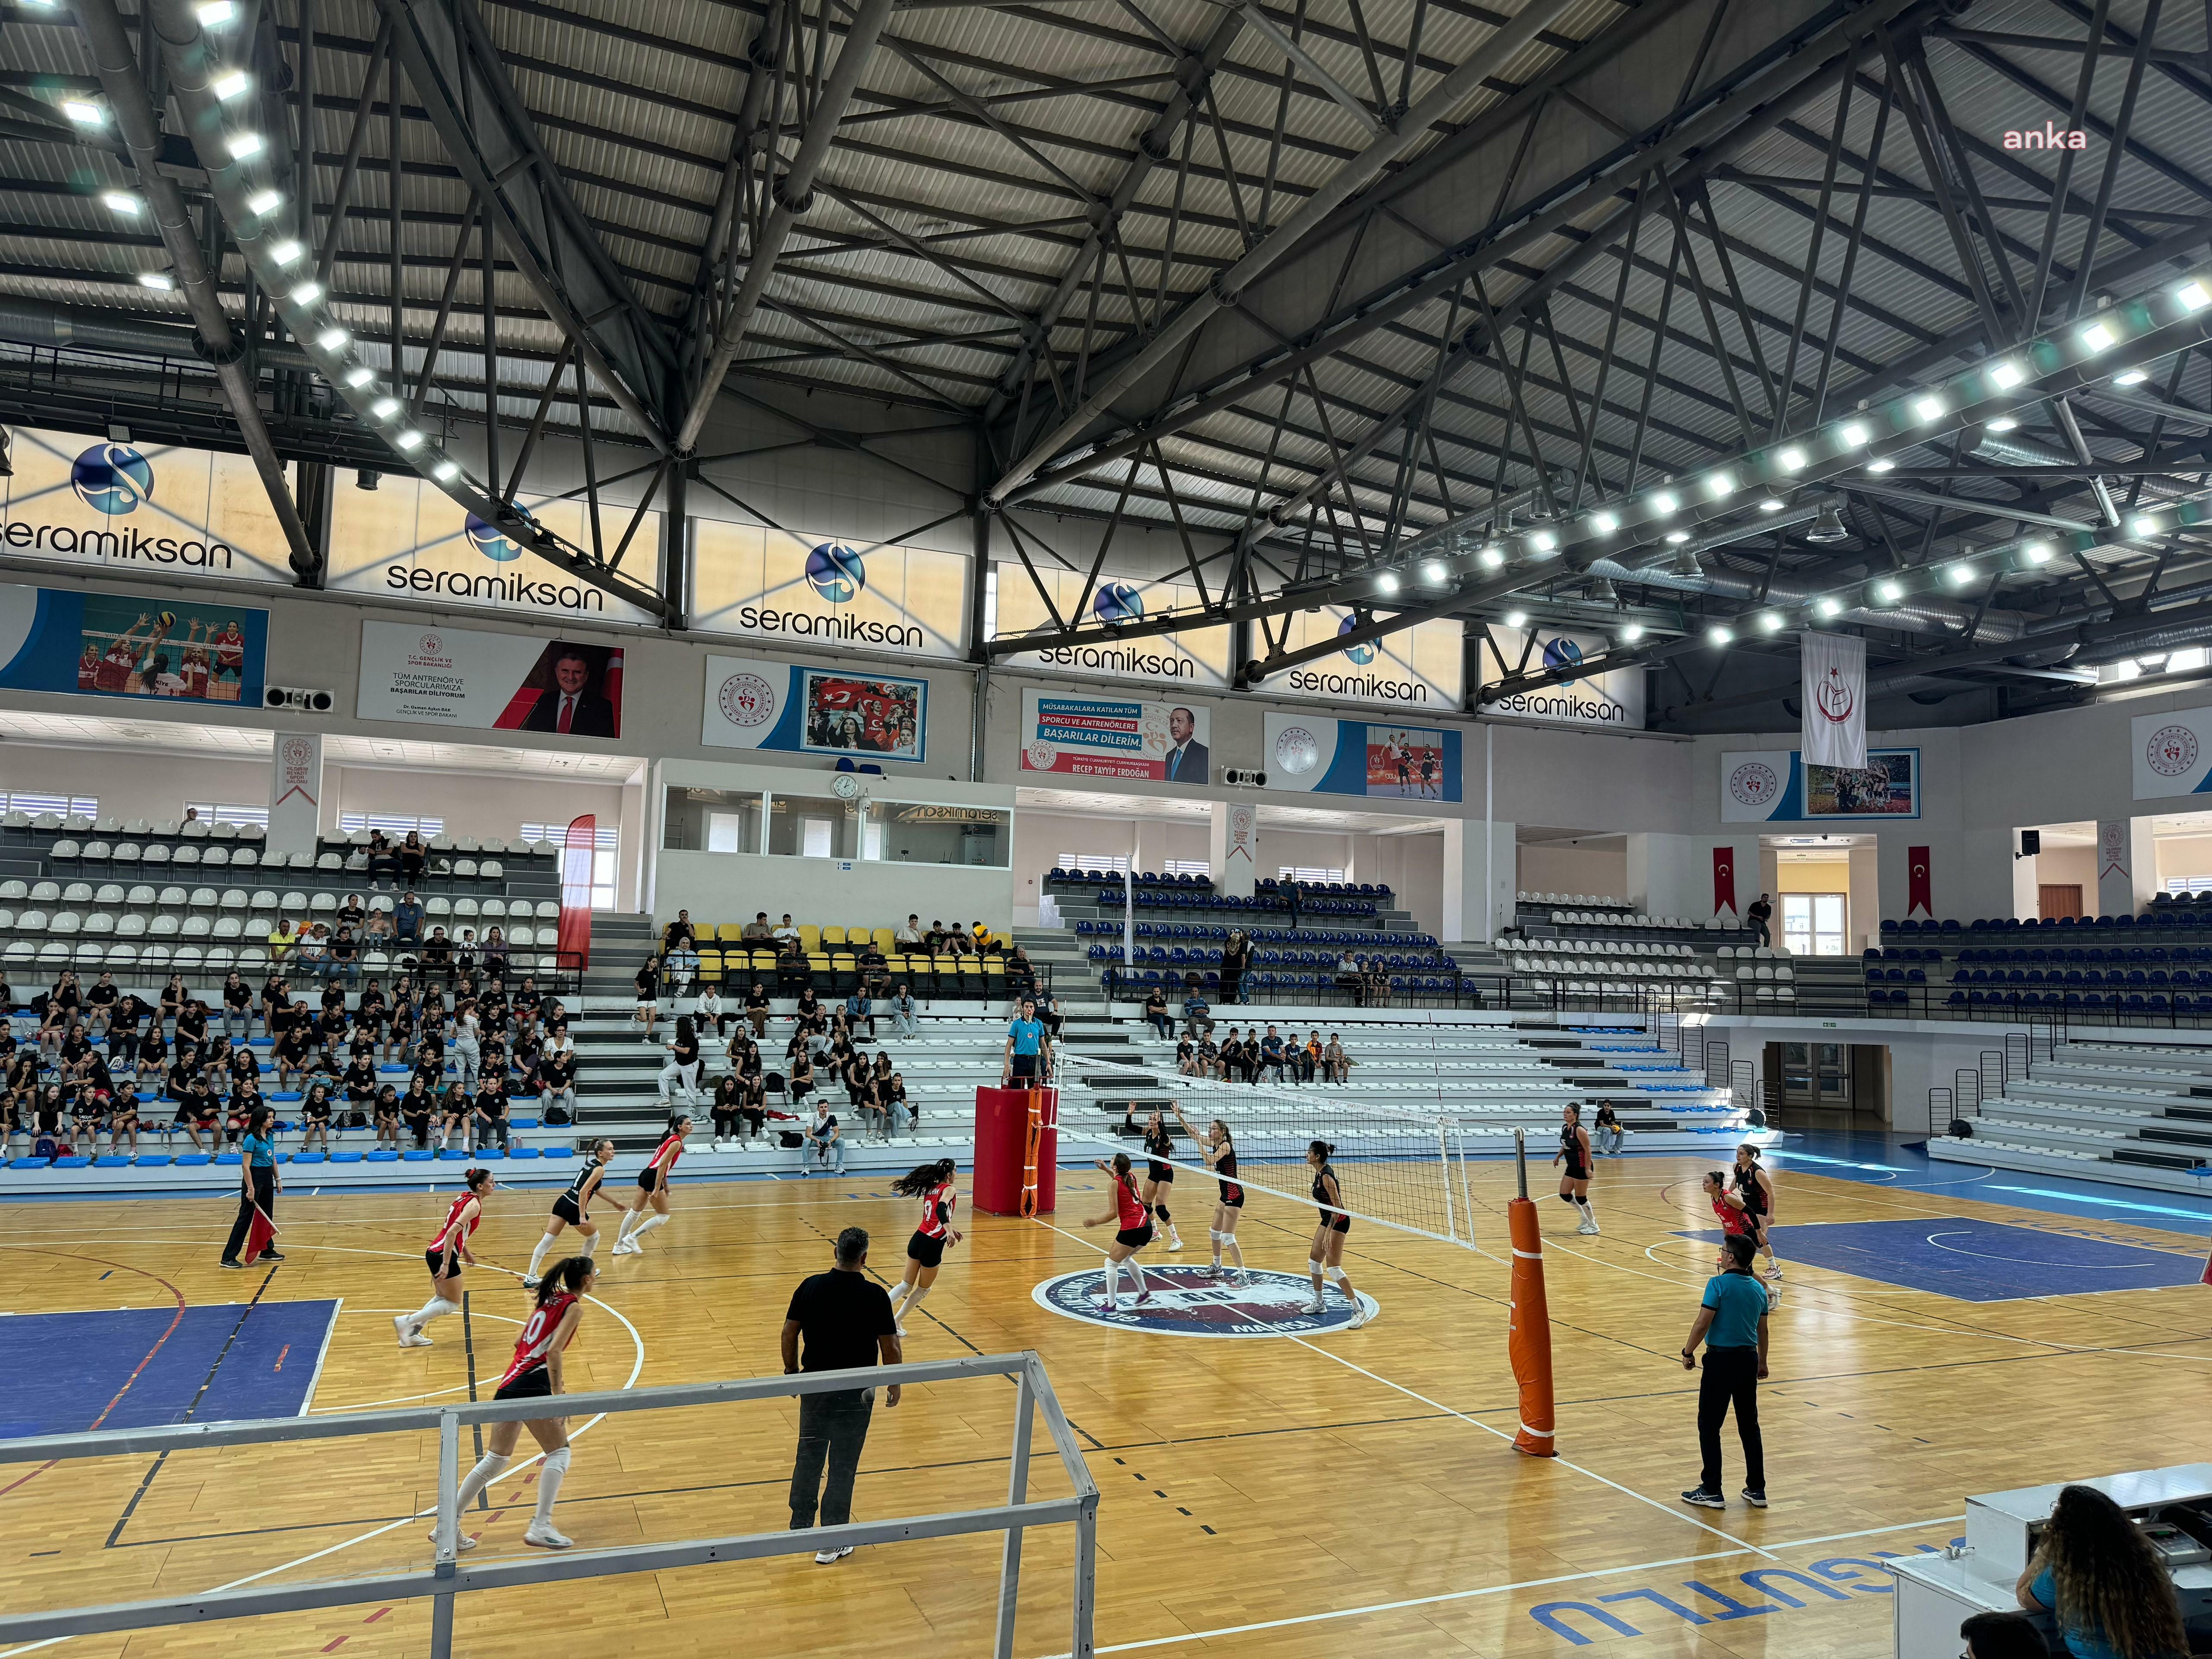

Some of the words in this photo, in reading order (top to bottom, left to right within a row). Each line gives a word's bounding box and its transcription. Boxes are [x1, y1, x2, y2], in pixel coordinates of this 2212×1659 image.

[0, 521, 232, 569] eramiksan
[387, 565, 603, 611] seramiksan
[740, 607, 923, 648] seramiksan
[1039, 647, 1194, 678] seramiksan
[395, 680, 461, 691] SPORCULARIMIZA
[412, 675, 453, 683] ANTRENÖR
[1289, 670, 1427, 702] seramiksan
[429, 690, 465, 699] DİLİYORUM
[1042, 703, 1095, 712] MÜSABAKALARA
[1500, 694, 1624, 722] seramiksan
[1081, 719, 1135, 730] ANTRENÖRLERE
[1044, 728, 1098, 742] BAŞARILAR
[1100, 734, 1141, 747] DİLERİM.
[1073, 764, 1092, 773] RECEP
[1094, 765, 1116, 775] TAYYİP
[1117, 767, 1149, 778] ERDOĞAN
[1231, 1320, 1320, 1333] MANİSA
